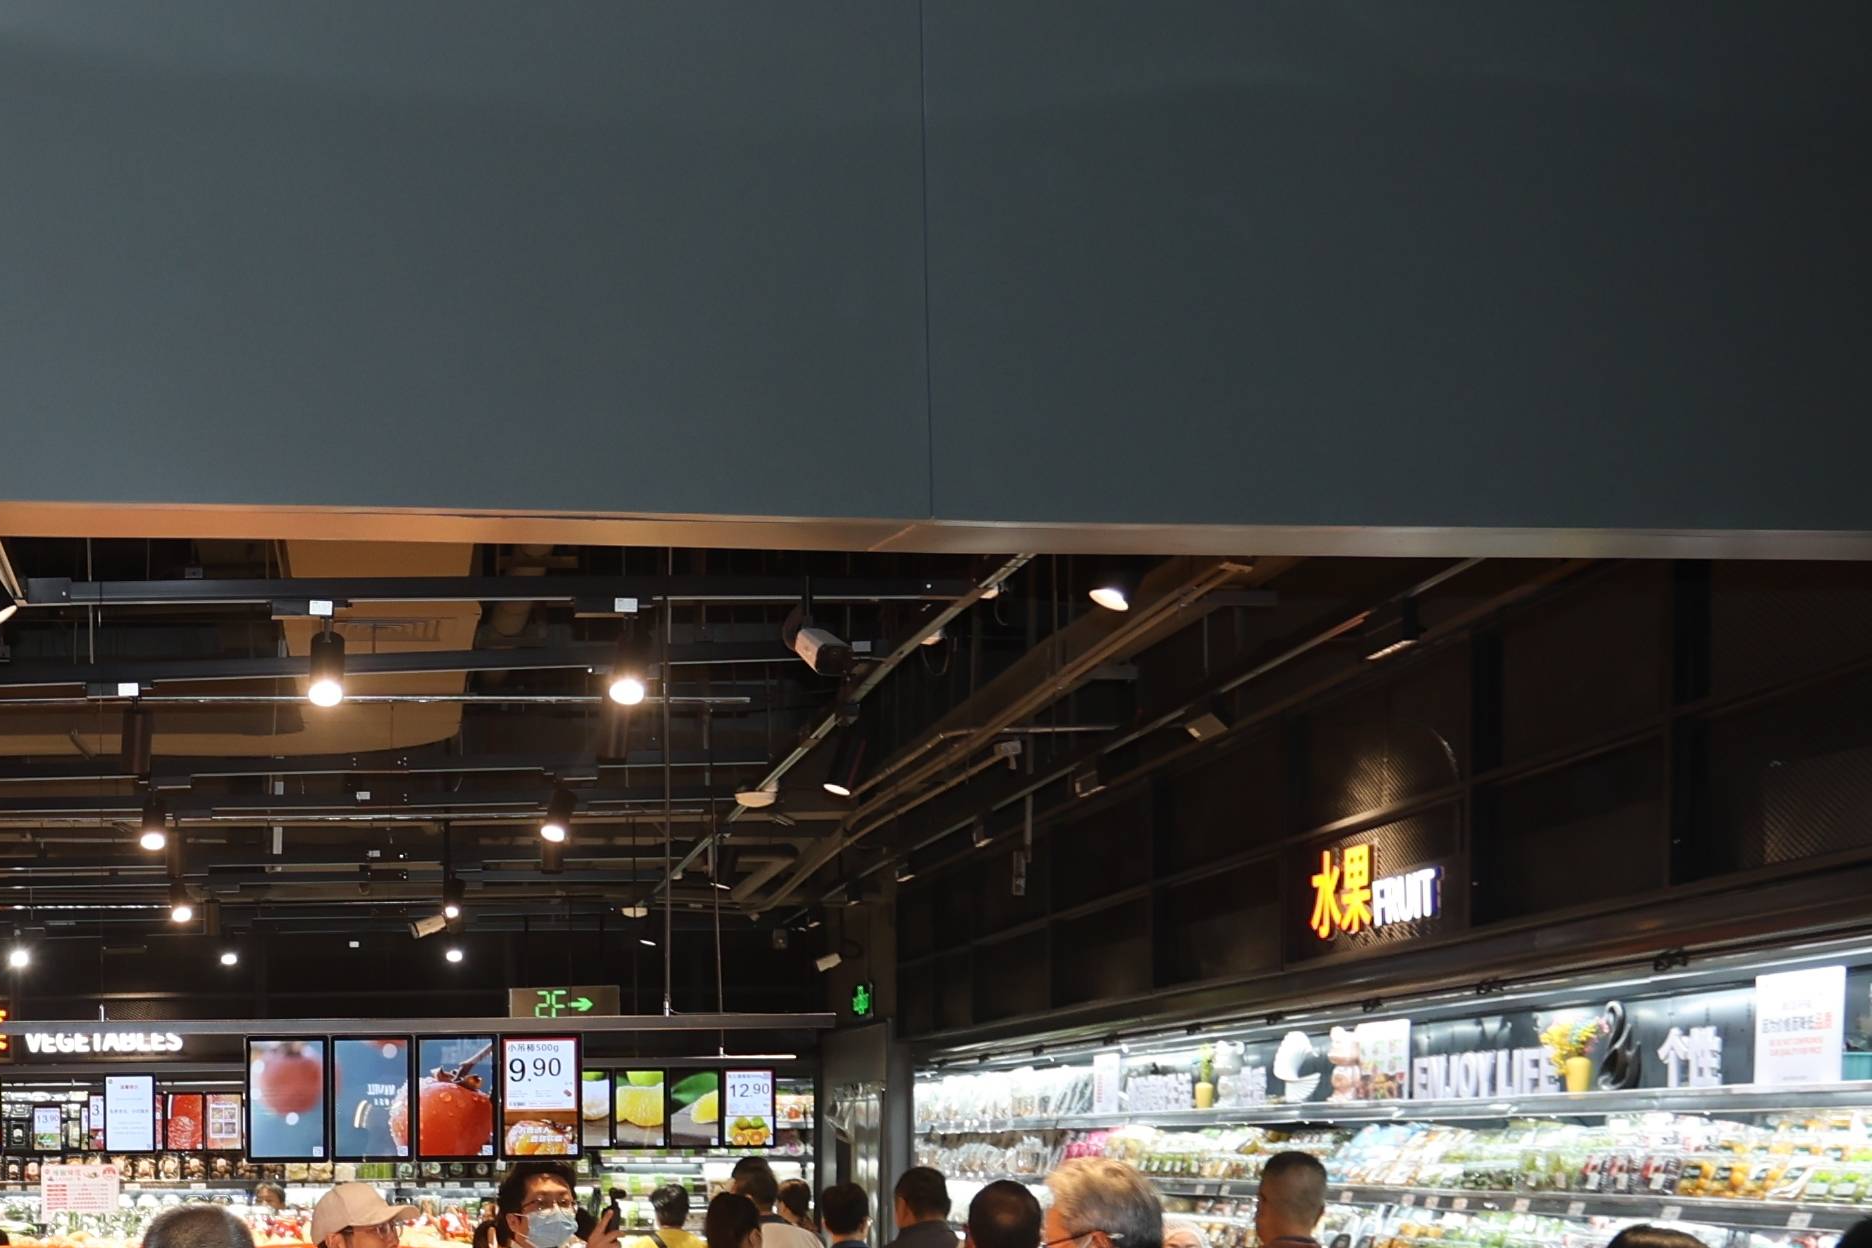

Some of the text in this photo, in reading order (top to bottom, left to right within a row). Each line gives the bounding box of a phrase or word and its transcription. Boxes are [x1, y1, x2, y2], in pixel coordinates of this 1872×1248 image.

[1311, 844, 1372, 938] 水果
[1372, 868, 1436, 927] FRUIT
[535, 990, 567, 1018] 2F
[25, 1032, 183, 1053] VEGETABLES
[509, 1057, 562, 1083] 9.90
[1414, 1047, 1560, 1100] ENJOY LIFE
[730, 1082, 770, 1098] 12.90
